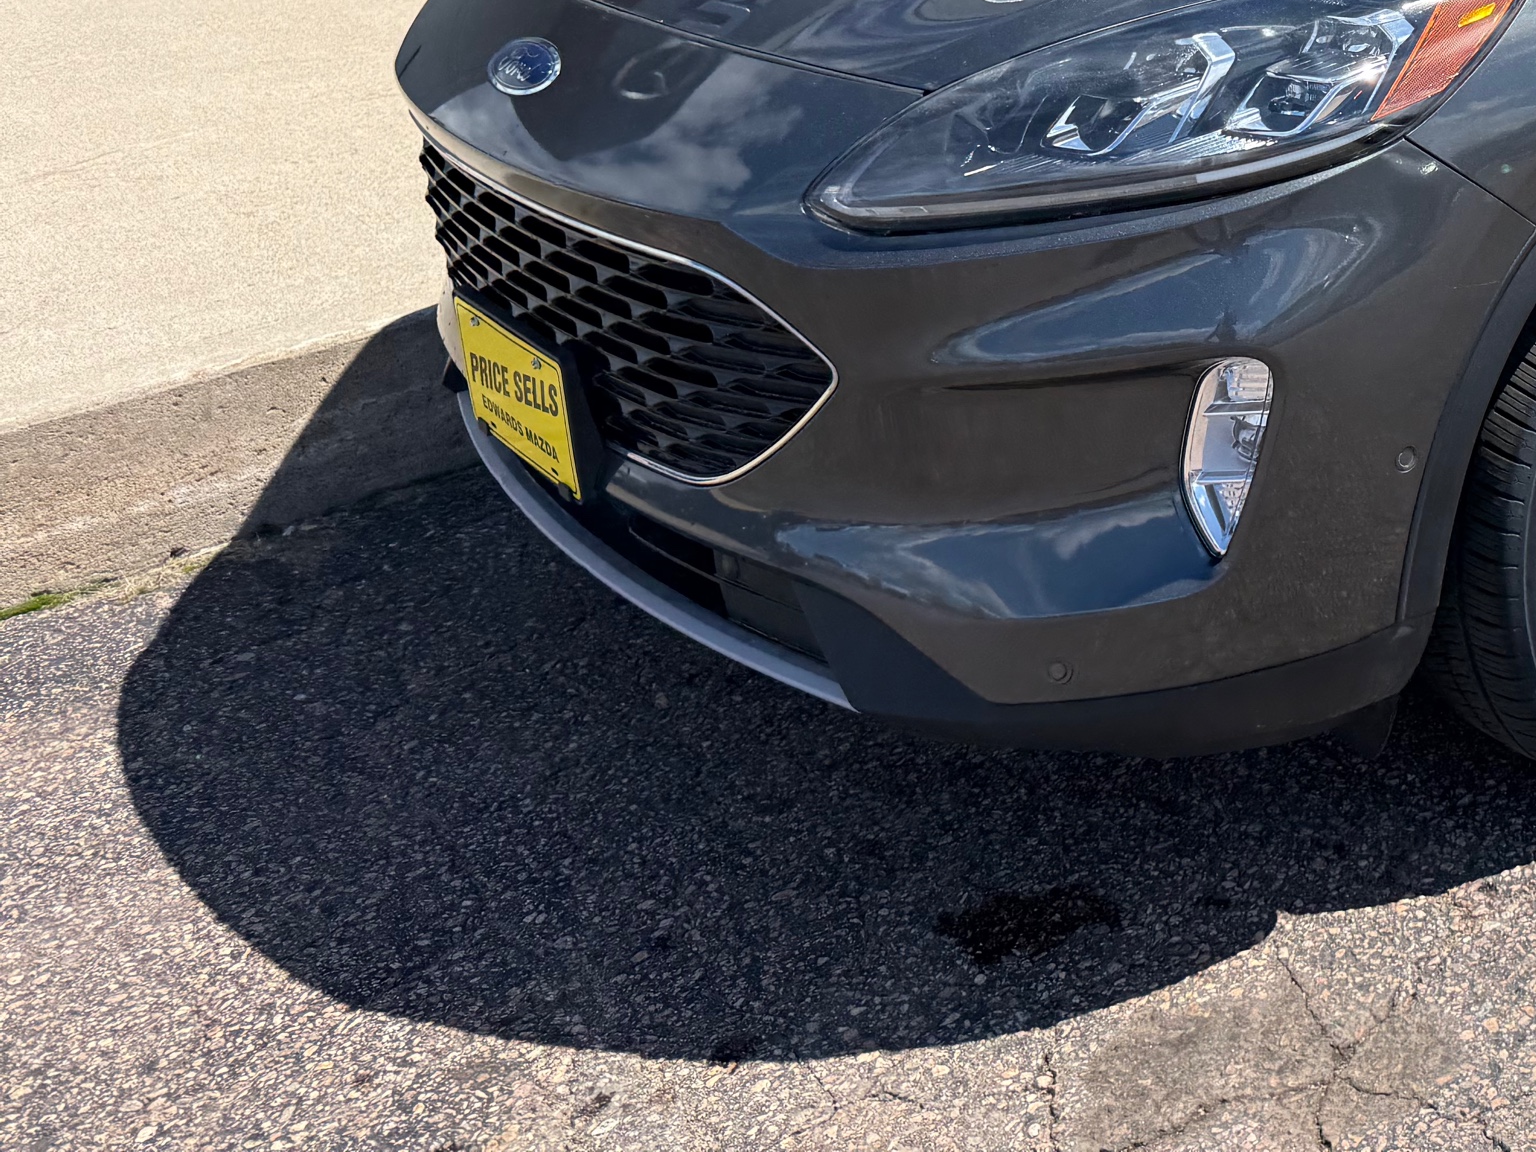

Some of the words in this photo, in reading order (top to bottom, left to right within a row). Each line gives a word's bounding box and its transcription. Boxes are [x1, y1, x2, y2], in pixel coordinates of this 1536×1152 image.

[469, 352, 511, 398] PRICE
[513, 370, 559, 417] SELLS
[481, 394, 524, 437] EDWARDS
[524, 426, 560, 463] MAZDA
